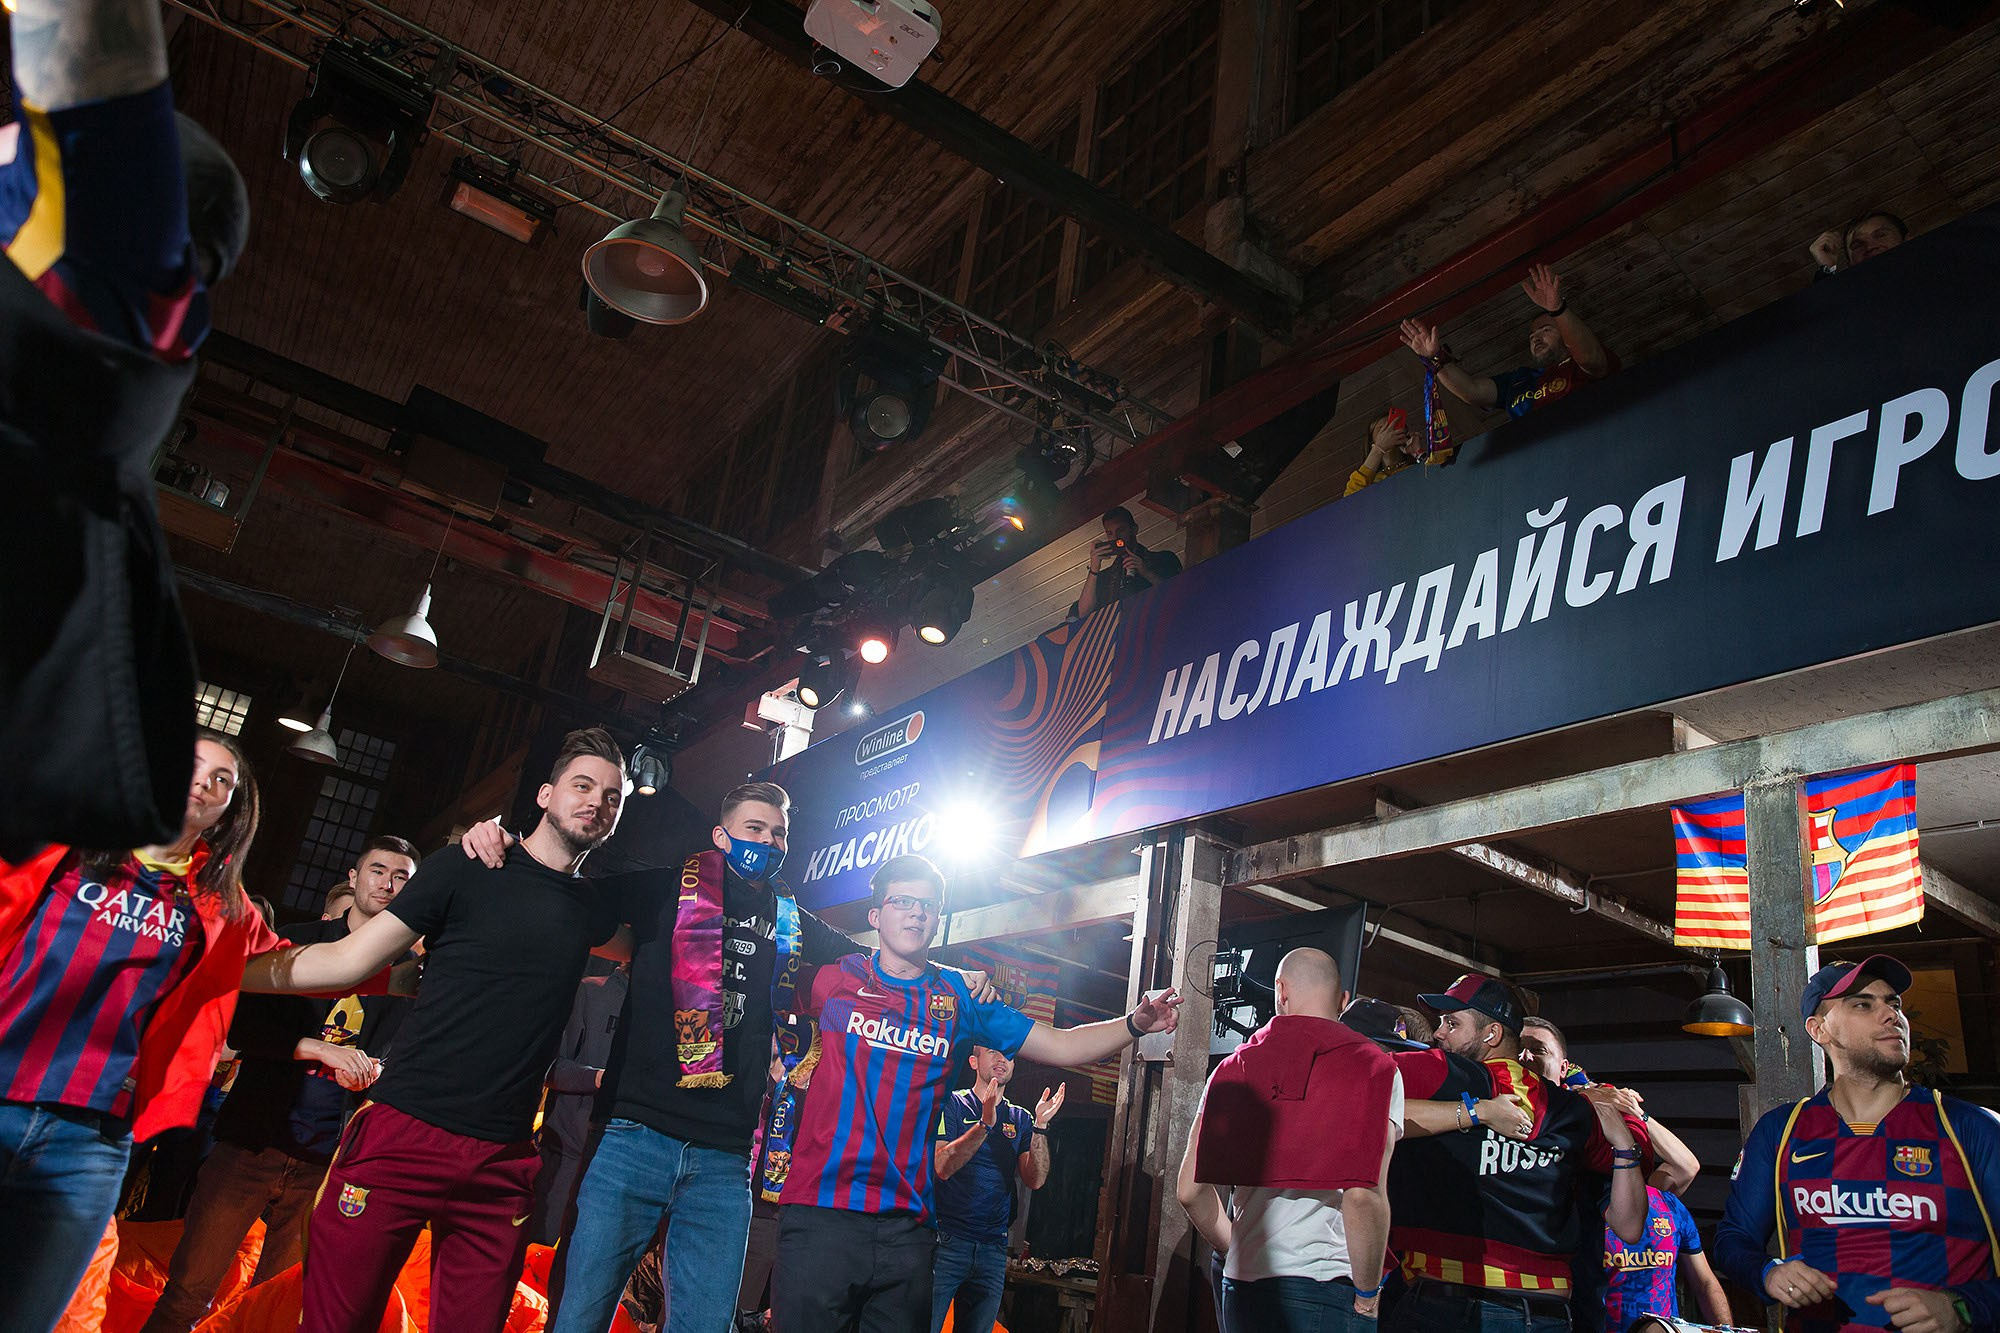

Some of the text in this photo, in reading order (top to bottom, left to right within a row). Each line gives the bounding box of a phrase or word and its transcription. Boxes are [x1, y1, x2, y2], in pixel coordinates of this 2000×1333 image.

[900, 23, 924, 39] acer
[1511, 382, 1548, 408] uncef
[1148, 476, 1686, 745] НАСЛАЖДАЙСЯ
[834, 782, 920, 829] ПРОСМОТР
[803, 812, 935, 884] КЛАСИКО
[77, 882, 185, 933] QATAR
[96, 910, 183, 947] AIRWAYS
[847, 1011, 950, 1058] Rakuten
[1794, 1185, 1938, 1222] Rakuten
[1603, 1248, 1674, 1268] Rakuten
